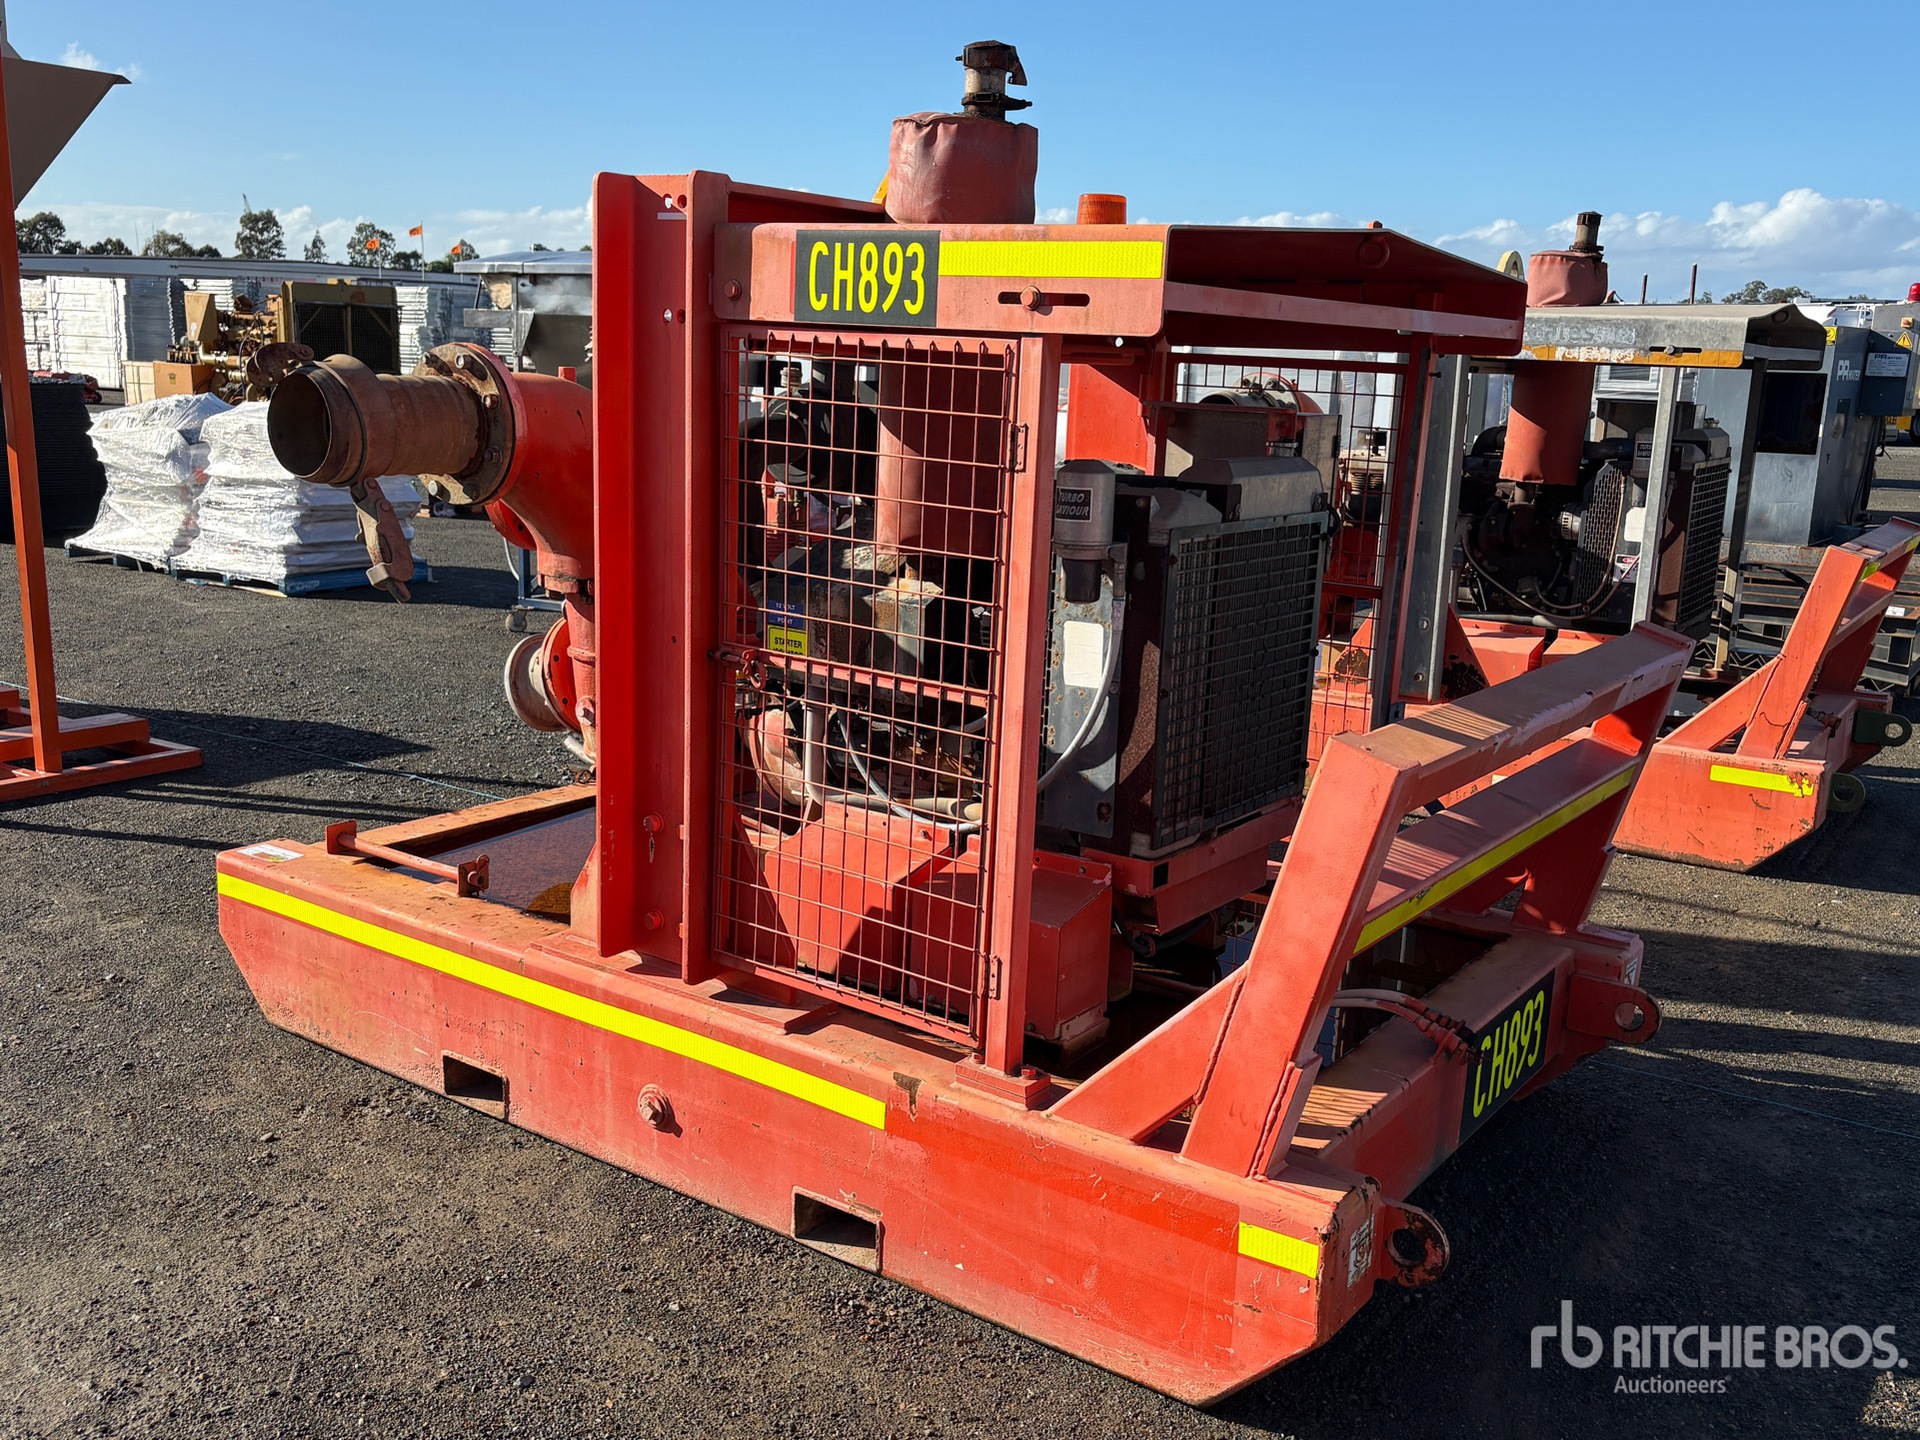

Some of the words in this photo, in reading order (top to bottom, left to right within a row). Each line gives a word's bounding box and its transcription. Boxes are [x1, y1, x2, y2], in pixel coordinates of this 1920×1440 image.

[808, 241, 926, 316] CH893
[1058, 491, 1085, 503] TURBO
[777, 616, 793, 624] PONT
[1472, 990, 1546, 1119] CH893
